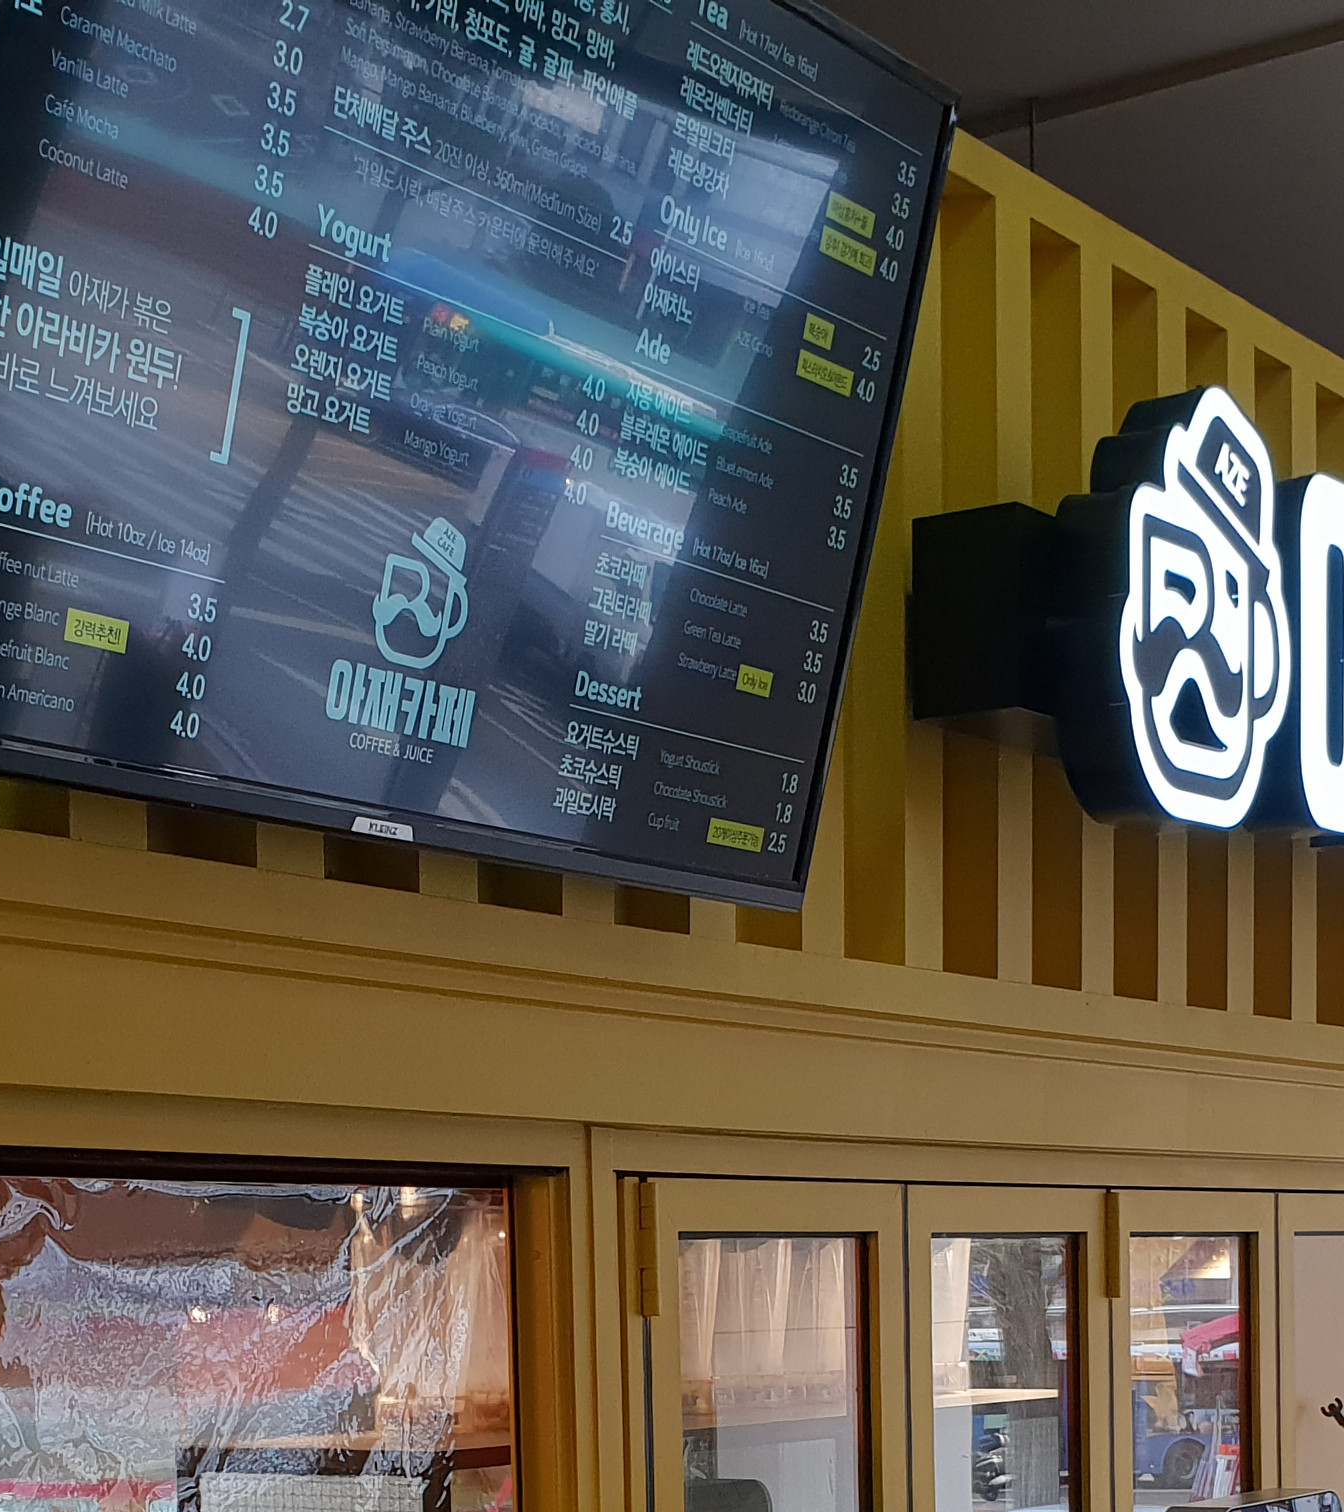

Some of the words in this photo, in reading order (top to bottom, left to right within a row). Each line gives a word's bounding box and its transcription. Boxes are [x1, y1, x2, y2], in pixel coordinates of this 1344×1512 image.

[60, 5, 115, 46] Caramel
[165, 6, 197, 35] Latte
[279, 0, 310, 33] 2.7
[394, 10, 450, 56] Strawberry
[51, 48, 93, 83] Vanilla
[96, 70, 129, 99] Latte
[273, 40, 304, 76] 3.0
[267, 81, 297, 117] 3.5
[76, 105, 119, 140] Mocha
[260, 123, 291, 157] 3.5
[39, 138, 94, 178] Coconut
[96, 156, 129, 190] Latte
[333, 85, 400, 143] 단체배달
[400, 117, 432, 155] 주스
[609, 214, 634, 246] 2.5
[897, 160, 918, 189] 3.5
[254, 164, 284, 198] 3.5
[248, 206, 279, 239] 4.0
[660, 194, 704, 245] Only
[705, 216, 728, 251] Ice
[891, 192, 911, 220] 3.5
[317, 203, 392, 263] Yogurt
[885, 225, 905, 251] 4.0
[650, 248, 701, 292] 아이스티
[879, 256, 899, 283] 4.0
[69, 270, 129, 320] 아재가
[132, 292, 173, 335] 볶은
[305, 263, 355, 309] 플레인
[355, 285, 405, 326] 요거트
[16, 303, 121, 374] 아라비카
[126, 338, 182, 391] 원두!
[298, 303, 349, 348] 복숭아
[353, 323, 399, 364] 요거트
[635, 328, 671, 365] Ade
[290, 343, 343, 387] 오렌지
[343, 362, 392, 402] 요거트
[862, 347, 882, 372] 2.5
[45, 367, 158, 431] 느껴보세요
[582, 374, 605, 402] 4.0
[856, 378, 876, 403] 4.0
[286, 382, 321, 418] 망고
[321, 396, 371, 435] 요거트
[576, 409, 599, 437] 4.0
[404, 429, 438, 458] Mango
[438, 440, 471, 467] Yogurt
[621, 412, 671, 455] 블루레몬
[672, 434, 709, 466] 에이드
[570, 444, 593, 472] 4.0
[613, 447, 653, 484] 복숭아
[655, 463, 691, 495] 에이드
[1214, 441, 1250, 507] AZE
[839, 464, 859, 490] 3.5
[833, 495, 853, 520] 3.5
[85, 511, 113, 540] [Hot
[117, 524, 146, 548] 10oz
[157, 533, 176, 556] Ice
[606, 501, 685, 553] Beverage
[827, 526, 847, 551] 3.5
[23, 561, 46, 581] nut
[47, 563, 79, 589] Latte
[23, 602, 60, 626] Blanc
[187, 593, 218, 624] 3.5
[181, 633, 212, 662] 4.0
[809, 619, 829, 644] 3.5
[34, 646, 70, 671] Blanc
[803, 650, 823, 674] 3.5
[7, 684, 75, 712] Americano
[175, 671, 206, 701] 4.0
[574, 670, 643, 713] Dessert
[797, 680, 817, 705] 3.0
[325, 659, 476, 749] 아재카페
[170, 710, 200, 739] 4.0
[349, 732, 392, 757] COFFEE
[402, 743, 434, 765] JUICE
[781, 772, 799, 796] 1.8
[553, 787, 617, 823] 과일도시락
[775, 801, 793, 825] 1.8
[768, 832, 787, 855] 2.5
